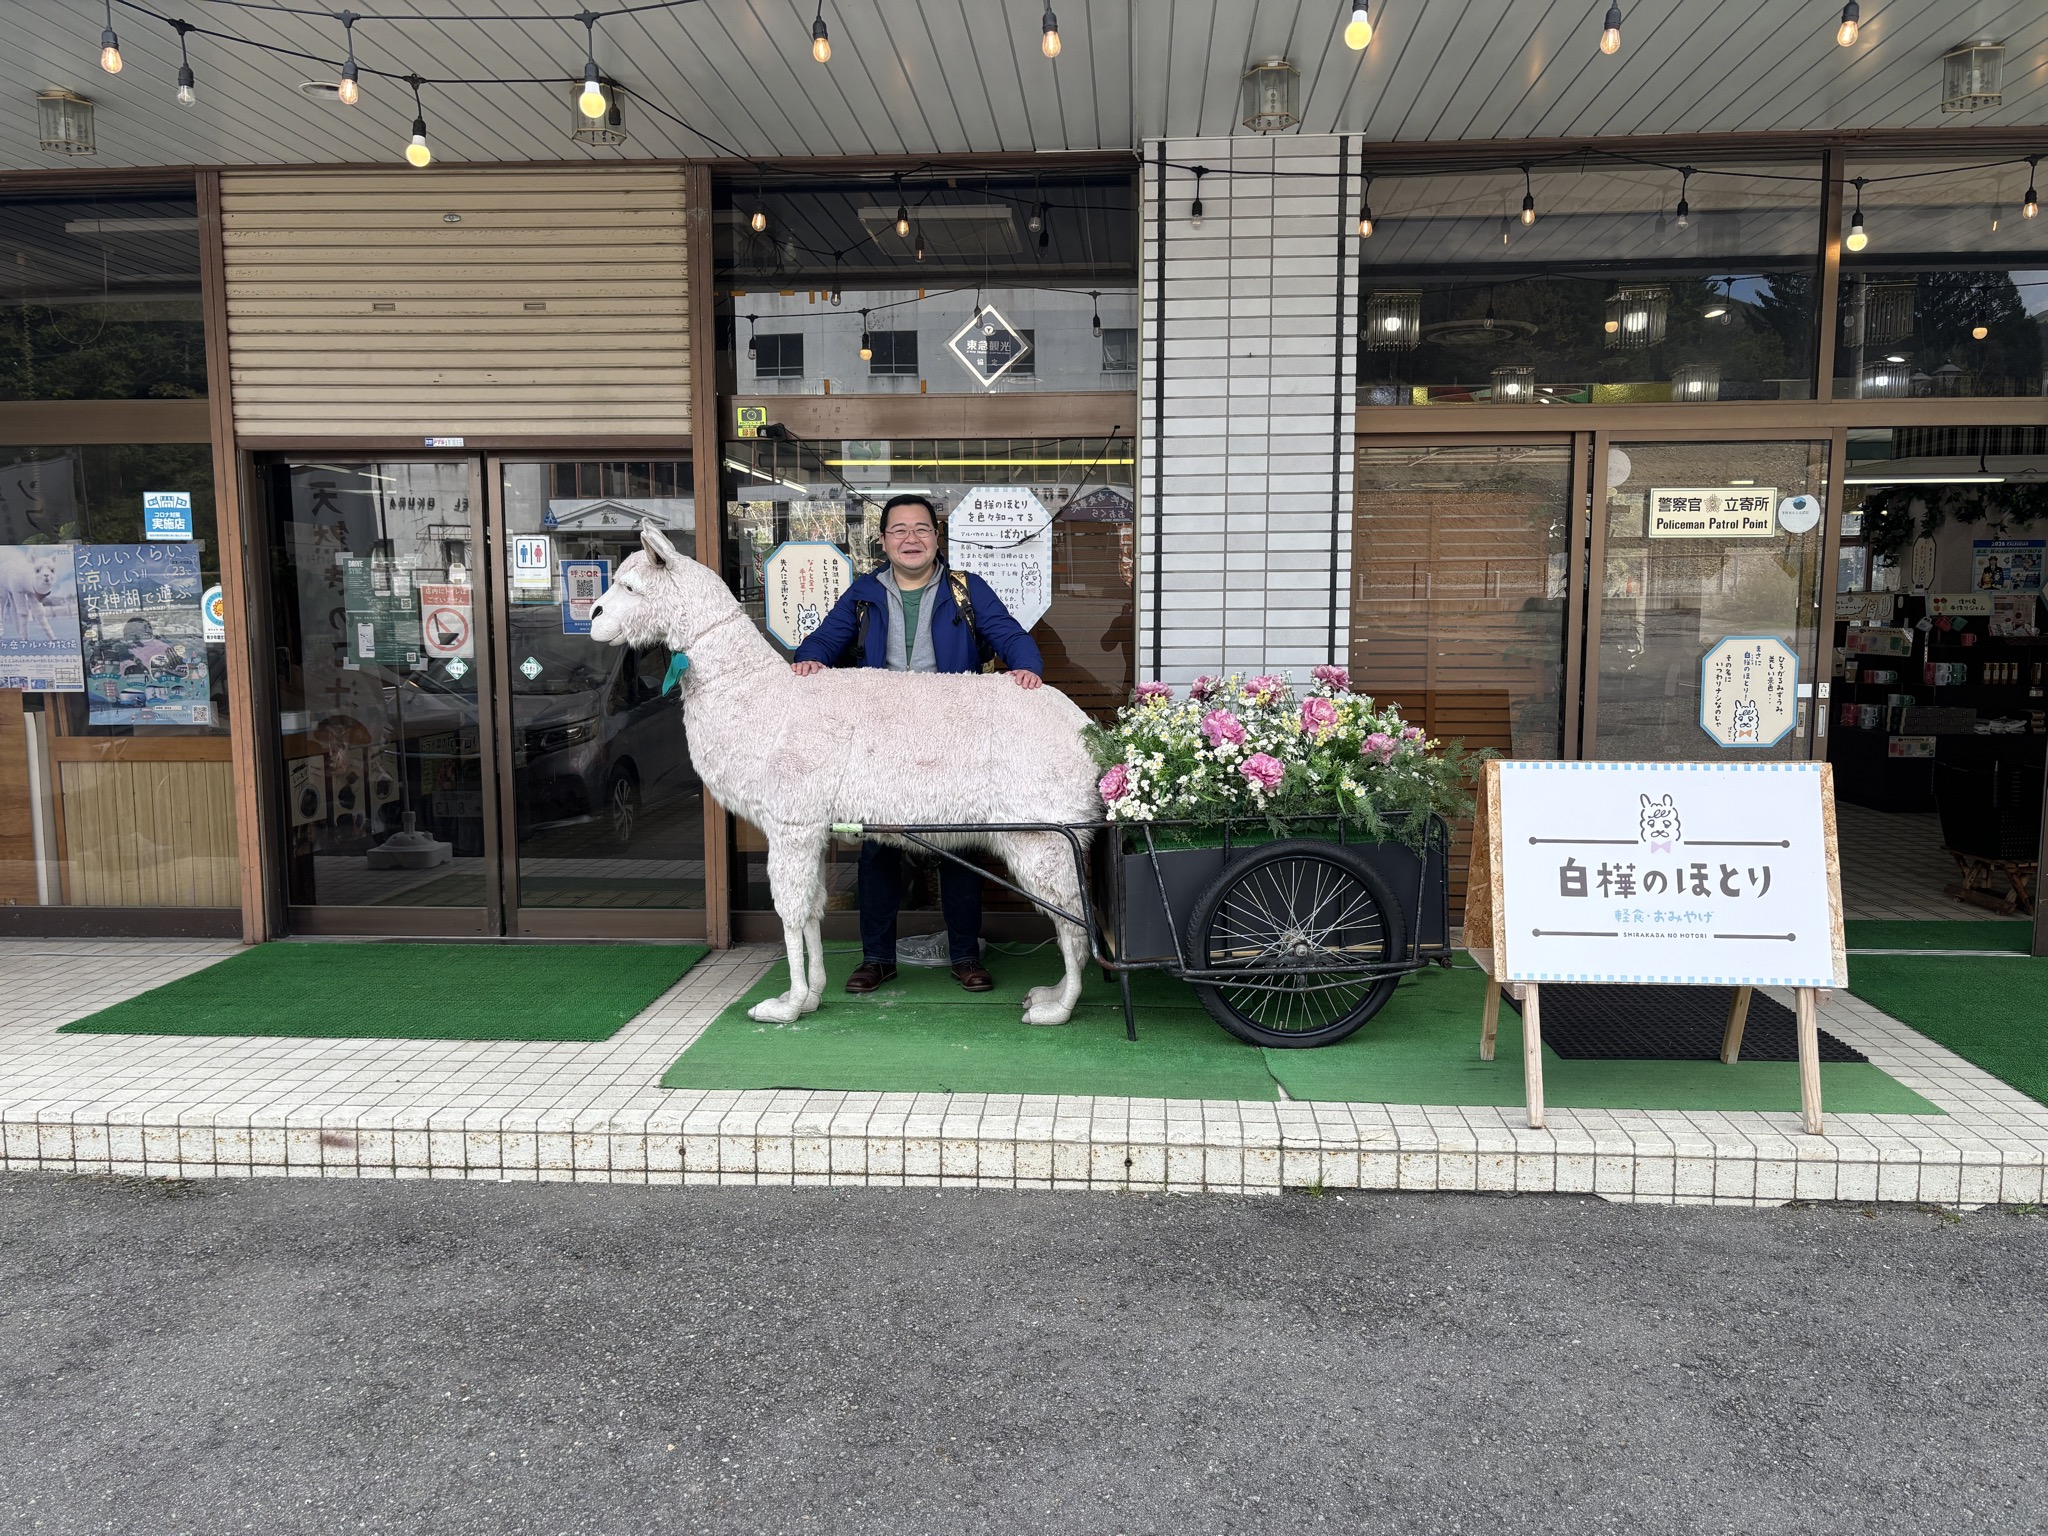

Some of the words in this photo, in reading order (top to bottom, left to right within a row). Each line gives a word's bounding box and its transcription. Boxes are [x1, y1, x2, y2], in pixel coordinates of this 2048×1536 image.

[966, 340, 1010, 352] 東急観光
[974, 498, 1028, 510] 白樺のほとり
[1658, 497, 1702, 512] 警察官
[1724, 496, 1770, 512] 立寄所
[152, 518, 186, 530] 実施店
[968, 512, 1034, 522] を色々知ってる
[1656, 518, 1705, 530] Policeman
[1709, 518, 1739, 530] Patrol
[1742, 517, 1768, 530] Point
[78, 544, 182, 568] ズルいくらい
[84, 583, 192, 612] 女神湖で遊ぶ
[1560, 856, 1772, 898] 白樺のほとり
[1614, 908, 1715, 924] 軽食・おみやげ
